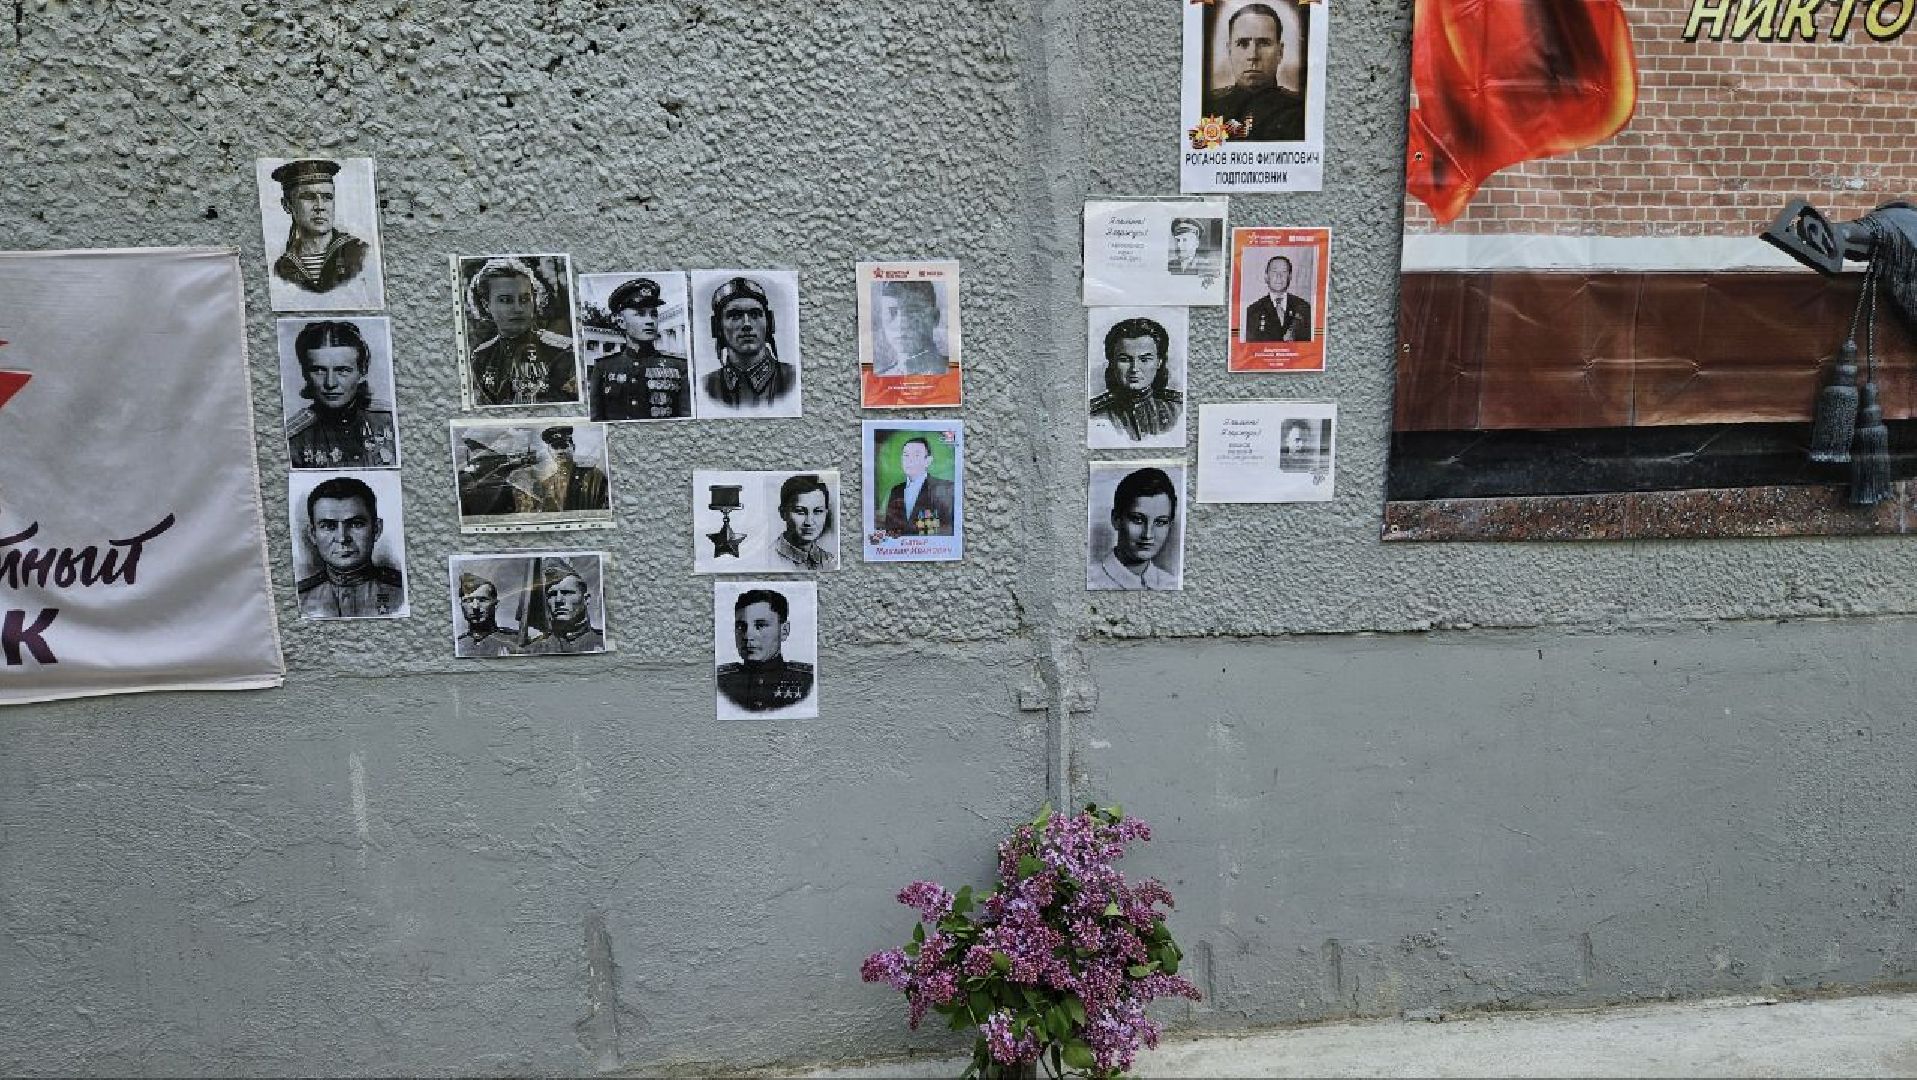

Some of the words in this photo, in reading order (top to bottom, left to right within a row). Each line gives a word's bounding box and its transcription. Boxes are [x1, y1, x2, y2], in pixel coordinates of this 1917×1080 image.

[1682, 0, 1915, 43] НИКТО
[1185, 153, 1227, 165] РОГАНОВ
[1230, 152, 1254, 165] ЯКОВ
[1256, 151, 1320, 165] ФИЛИППОВИЧ
[1215, 171, 1288, 185] ПОДПОЛКОВНИК
